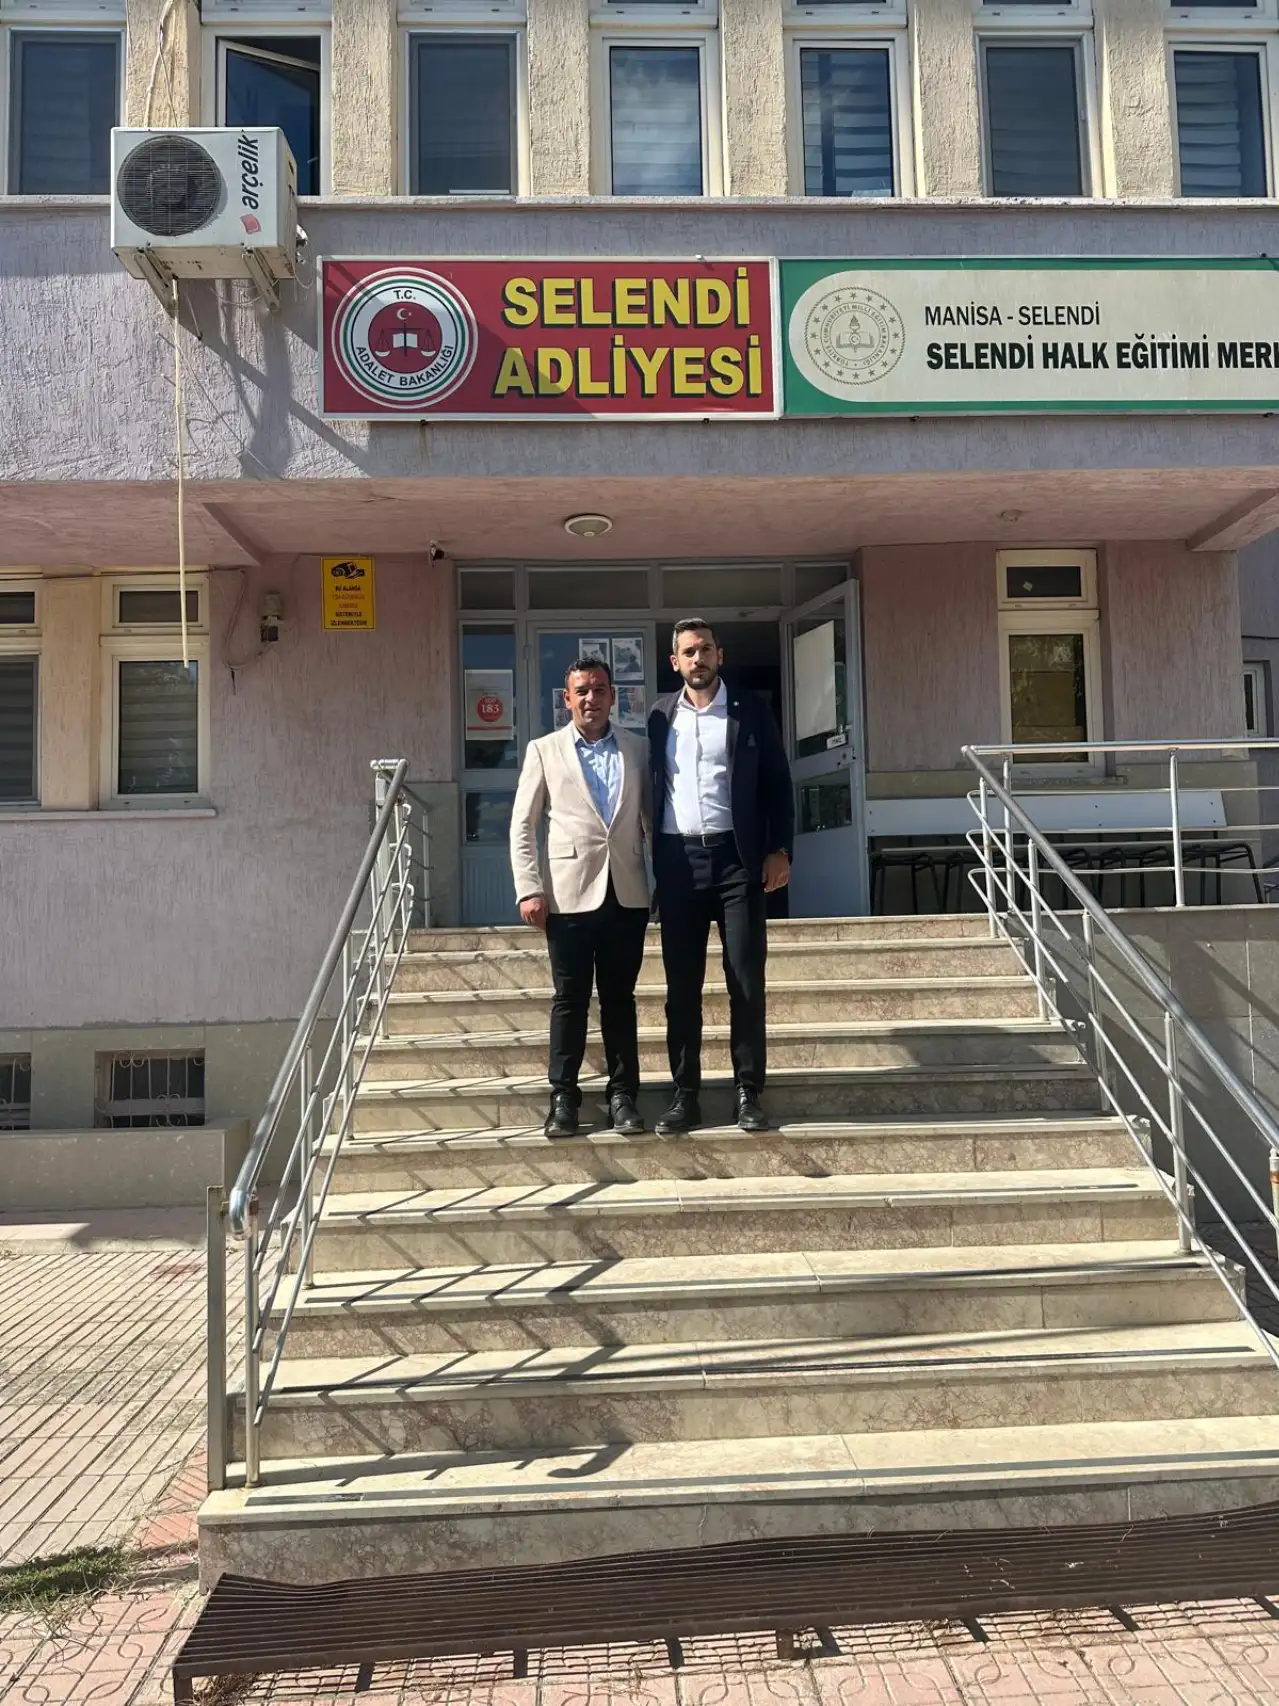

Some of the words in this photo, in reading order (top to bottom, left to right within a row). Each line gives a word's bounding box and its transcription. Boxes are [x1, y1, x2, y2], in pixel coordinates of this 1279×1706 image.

[238, 132, 263, 210] arçelik
[393, 289, 416, 300] T.C.
[502, 267, 750, 327] SELENDİ
[925, 301, 1002, 326] MANİSA
[1018, 301, 1100, 326] SELENDİ
[355, 345, 395, 384] ADALET
[399, 345, 454, 387] BAKANLIĞI
[492, 334, 762, 397] ADLİYESİ
[926, 334, 1035, 370] SELENDİ
[1042, 342, 1110, 369] HALK
[1116, 333, 1210, 369] EĞİTİMİ
[482, 703, 500, 713] 183
